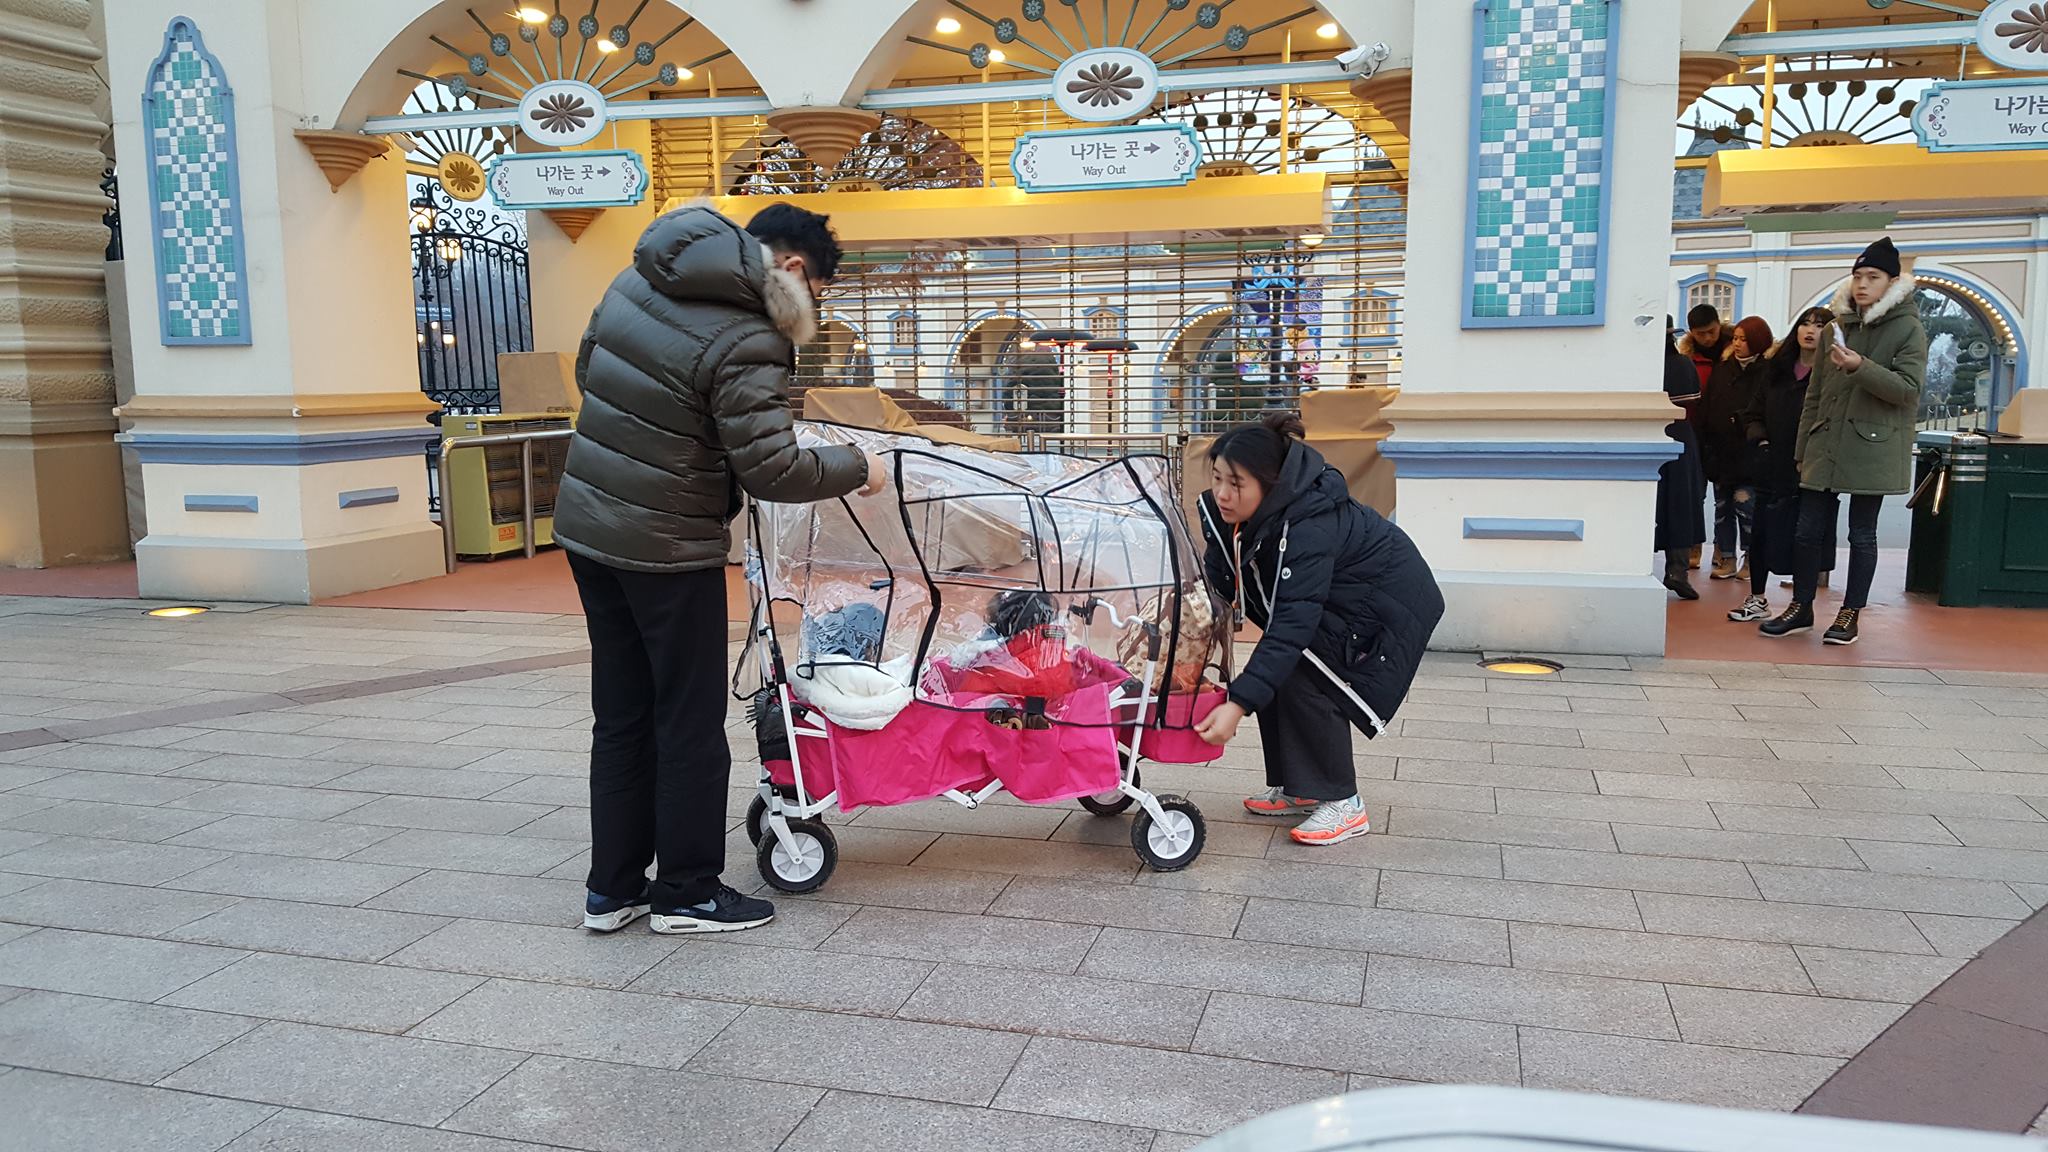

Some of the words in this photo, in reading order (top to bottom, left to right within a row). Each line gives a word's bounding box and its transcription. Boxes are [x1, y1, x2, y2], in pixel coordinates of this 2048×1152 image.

[2008, 123, 2037, 136] Way
[1070, 142, 1117, 160] 나가는
[1124, 140, 1140, 159] 곳
[536, 165, 576, 182] 나가는
[581, 164, 594, 180] 곳
[1082, 165, 1104, 178] Way
[1107, 164, 1127, 176] Out
[547, 186, 566, 197] Way
[567, 186, 584, 196] Out
